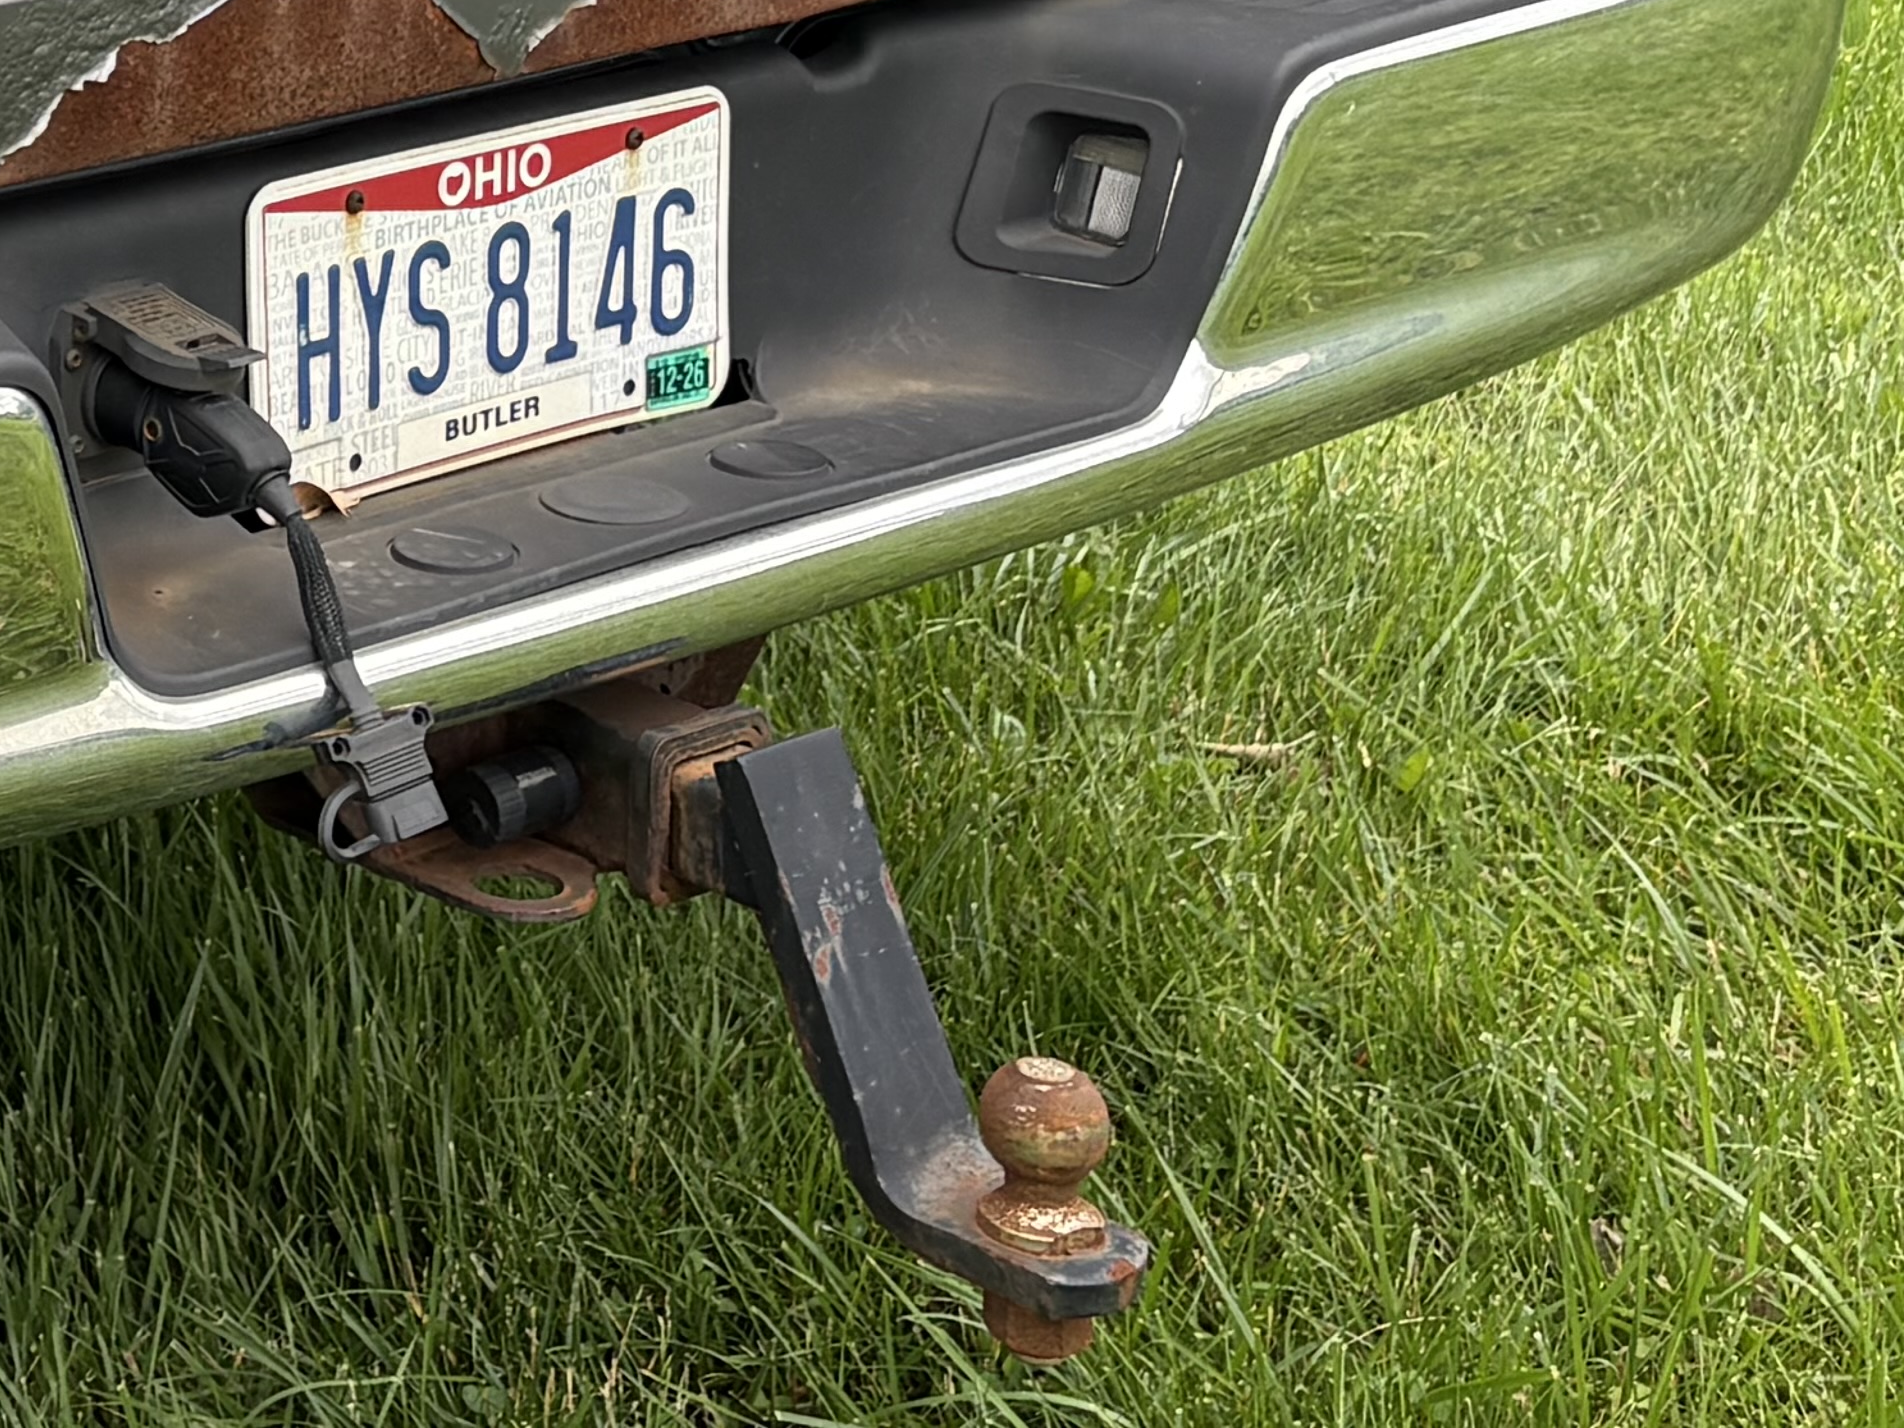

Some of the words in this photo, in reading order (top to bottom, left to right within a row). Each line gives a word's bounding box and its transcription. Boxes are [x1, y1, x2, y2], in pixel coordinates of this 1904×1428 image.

[437, 142, 552, 207] OHIO
[375, 210, 490, 250] BIRTHPLACE
[524, 175, 612, 213] AVIATION
[295, 240, 452, 431] HYS
[485, 187, 696, 374] 8146
[657, 358, 704, 395] 12-26
[444, 395, 541, 443] BUTLER
